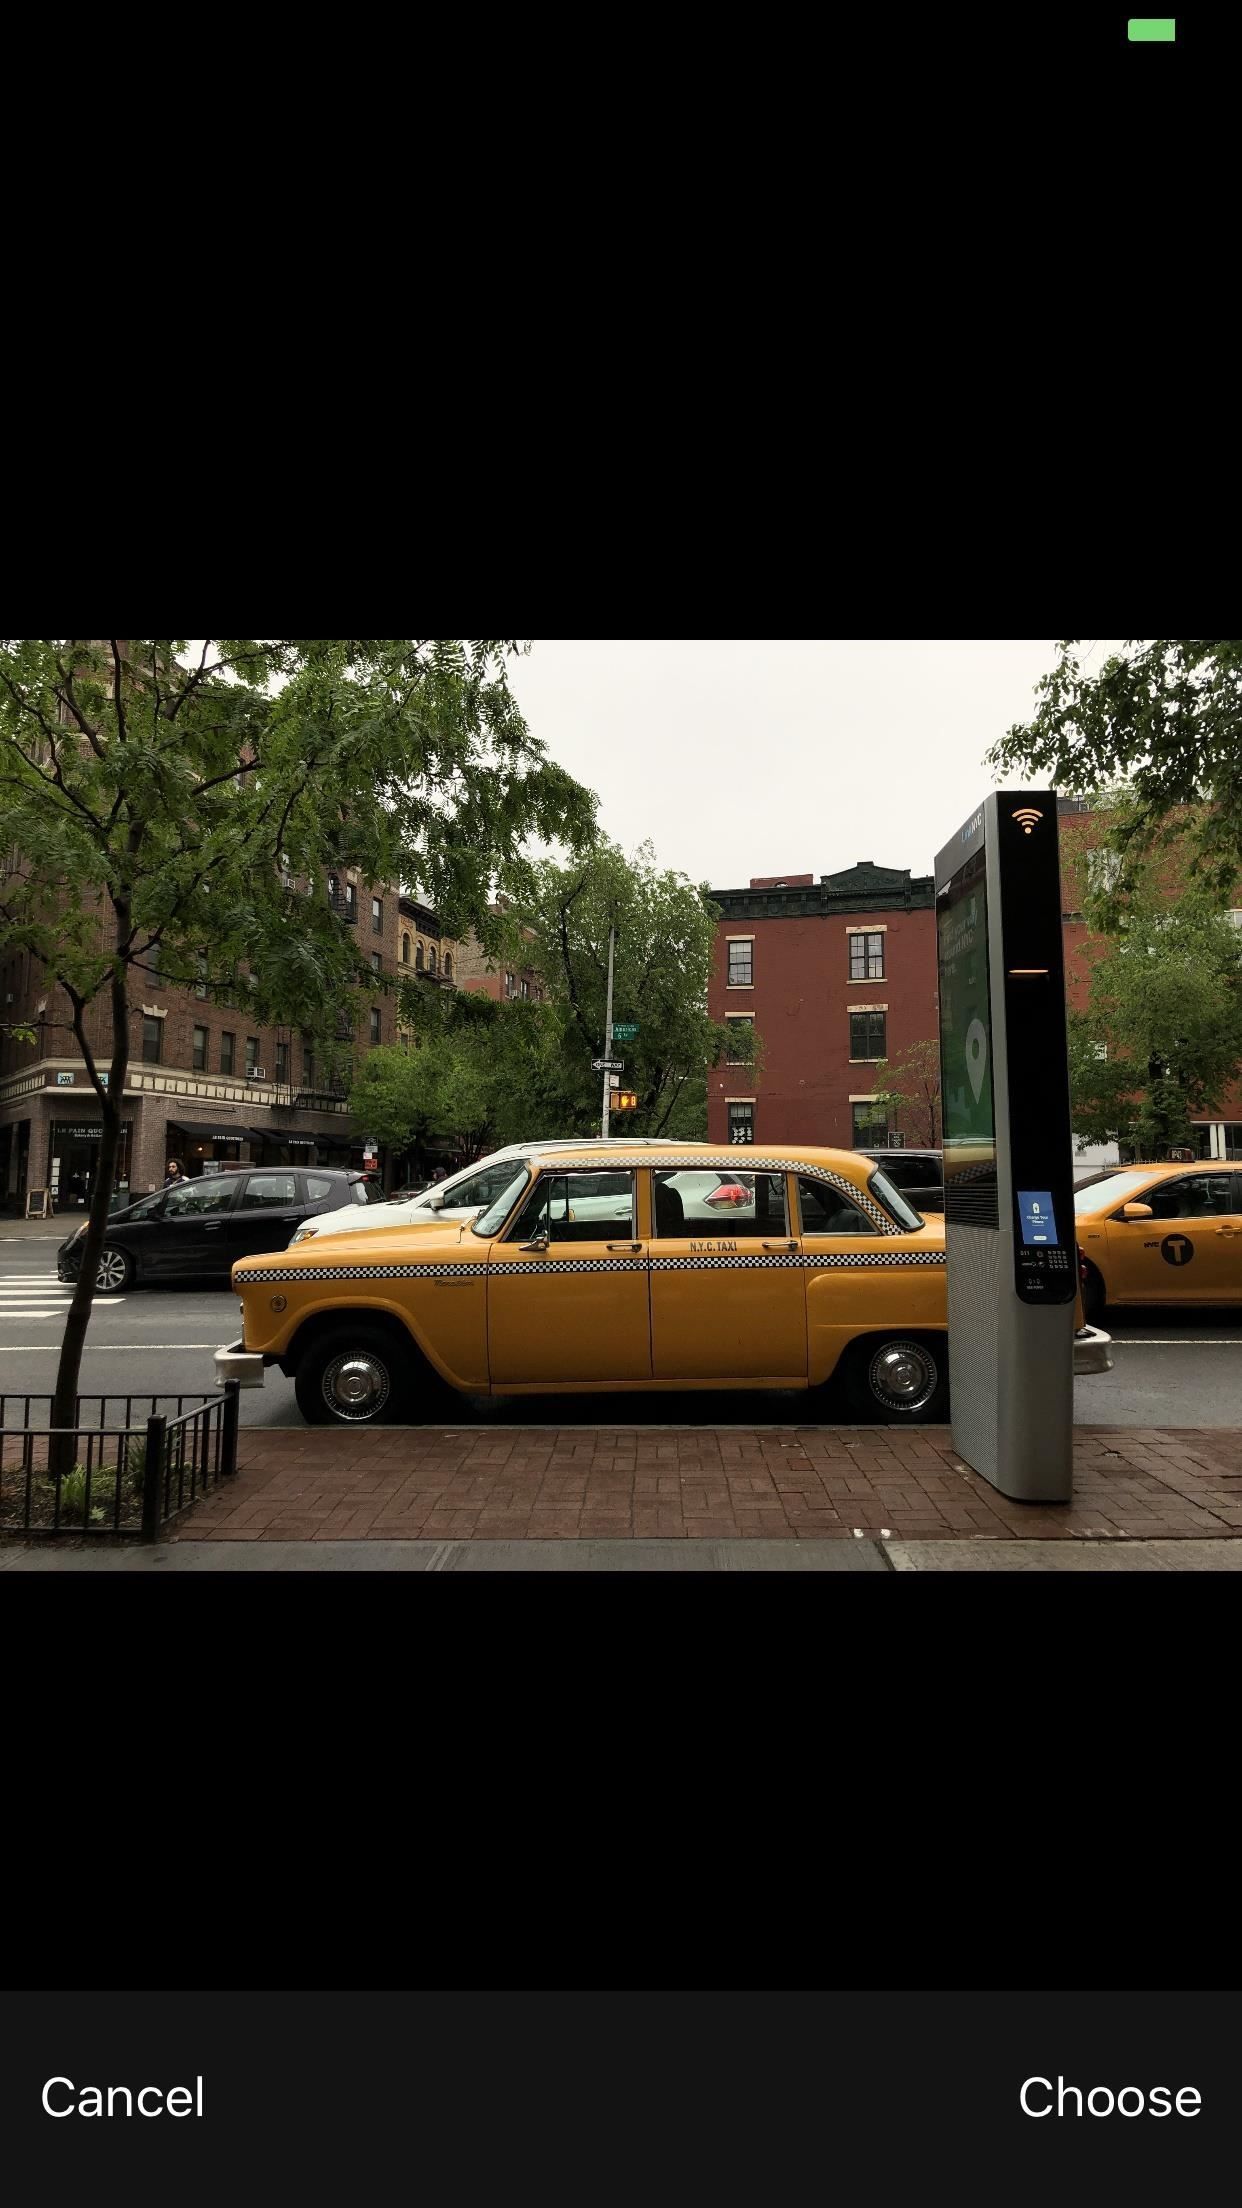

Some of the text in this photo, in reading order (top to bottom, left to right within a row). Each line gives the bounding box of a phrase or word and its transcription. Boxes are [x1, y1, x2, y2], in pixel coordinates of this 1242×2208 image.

[690, 1241, 737, 1252] N.Y.C. TAXI
[1167, 1240, 1186, 1262] T
